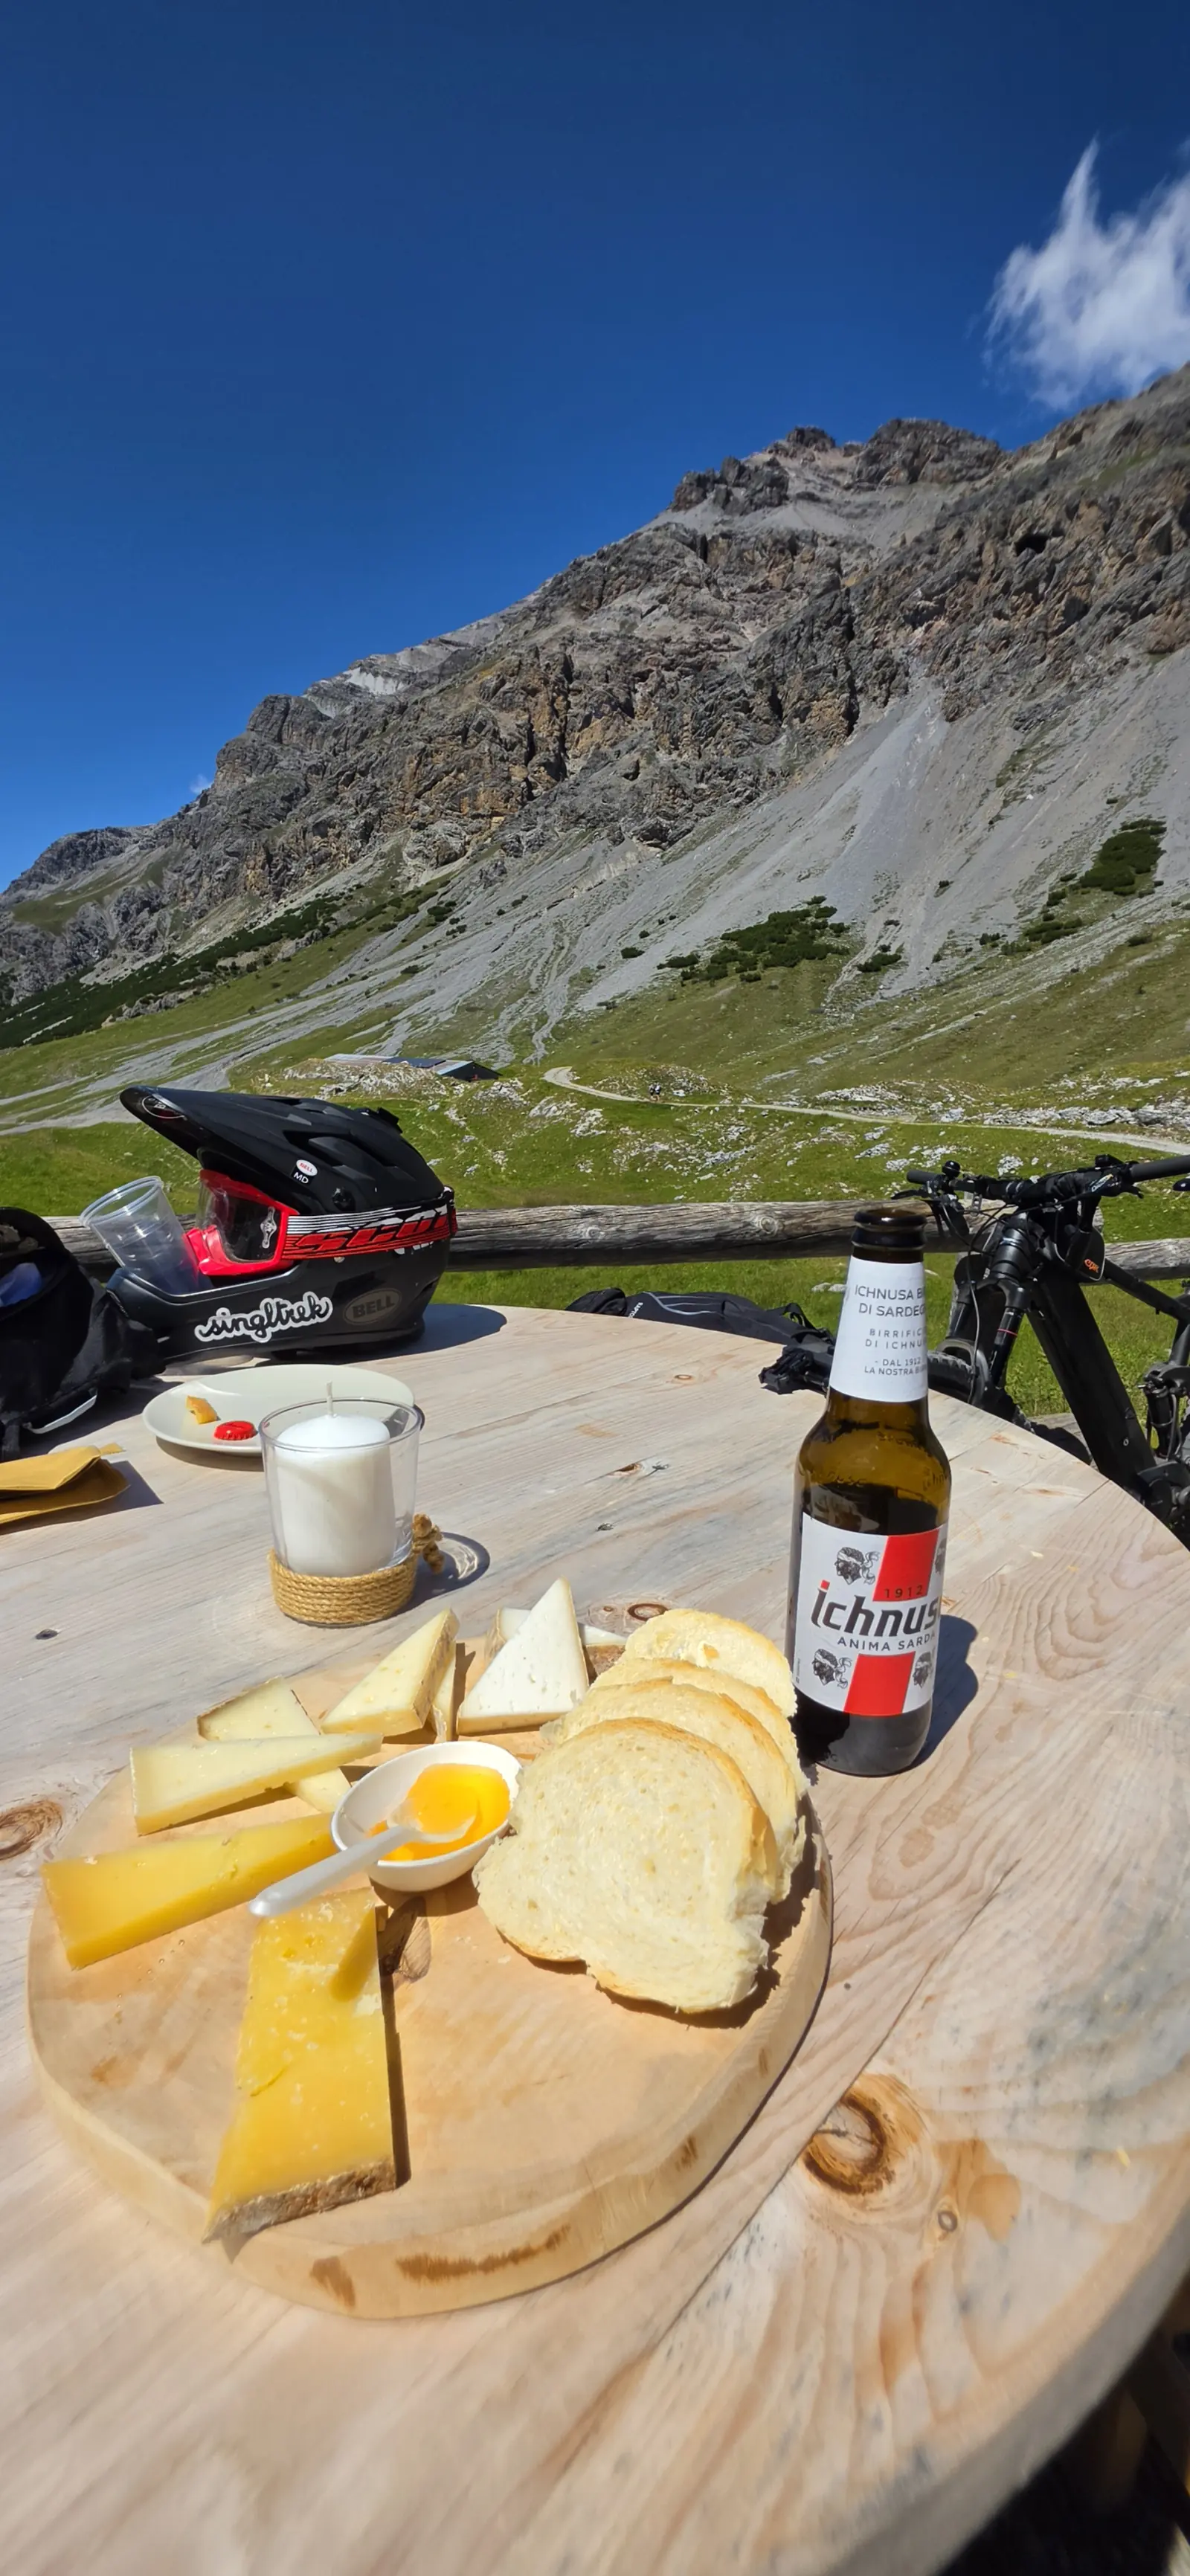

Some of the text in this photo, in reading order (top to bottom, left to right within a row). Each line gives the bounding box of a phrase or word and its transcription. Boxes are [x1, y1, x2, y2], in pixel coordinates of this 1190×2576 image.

[300, 1162, 313, 1173] BELL
[293, 1171, 309, 1184] MD
[855, 1284, 914, 1301] ICHNUSA
[353, 1295, 396, 1318] BELL
[858, 1302, 872, 1315] DI
[197, 1295, 331, 1339] singltrek
[865, 1339, 925, 1350] DI ICHNU
[882, 1359, 902, 1367] DAL
[904, 1356, 922, 1367] 1912
[864, 1365, 875, 1374] LA
[878, 1367, 914, 1376] NOSTRA
[884, 1584, 924, 1599] 1912
[811, 1579, 939, 1637] ichnus
[837, 1637, 891, 1651] ANIMA
